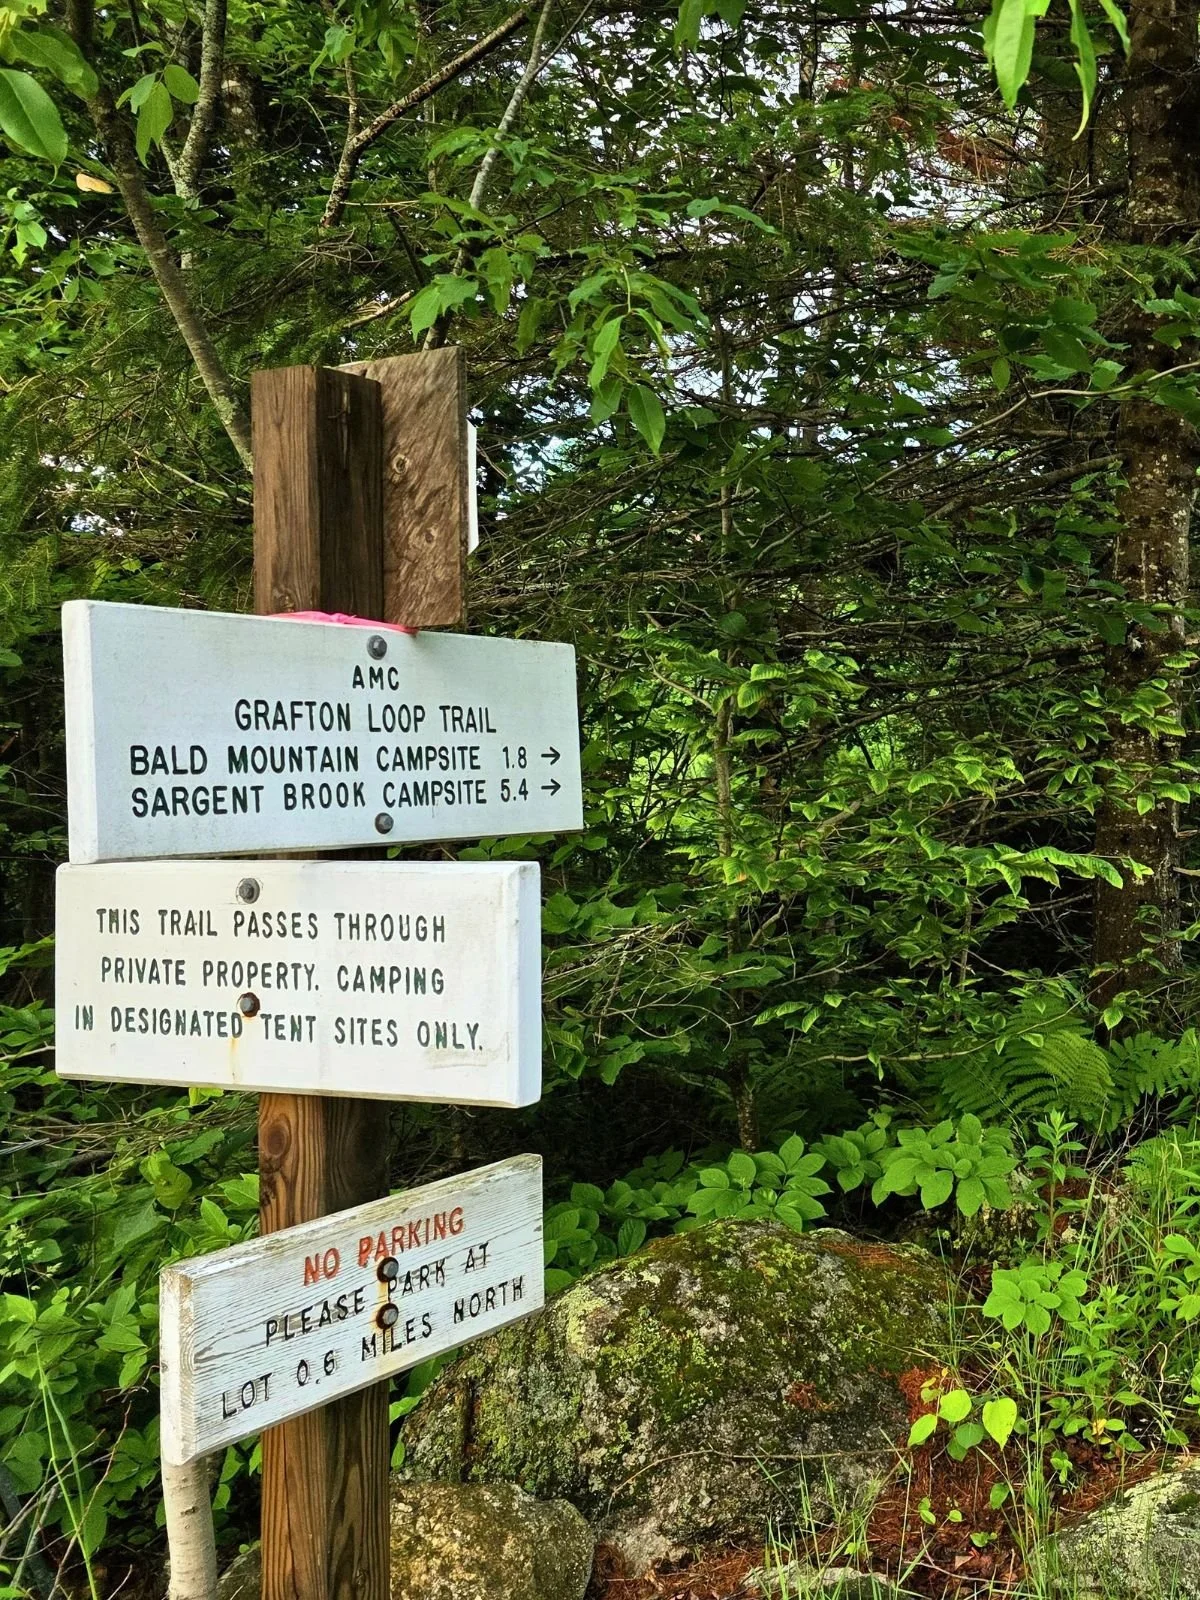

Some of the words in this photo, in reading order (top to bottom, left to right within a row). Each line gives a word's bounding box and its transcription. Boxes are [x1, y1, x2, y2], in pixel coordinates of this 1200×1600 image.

[352, 664, 400, 690] AMC
[234, 699, 352, 733] GRAFTON
[368, 704, 427, 733] LOOP
[439, 704, 497, 734] TRAIL
[129, 744, 208, 776] BALD
[227, 745, 359, 774] MOUNTAIN
[376, 745, 481, 772] CAMPSITE
[502, 747, 528, 769] 1.8
[131, 785, 265, 819] SARGENT
[284, 781, 365, 811] BROOK
[382, 779, 487, 808] CAMPSITE
[500, 778, 529, 801] 5.4
[96, 908, 140, 936] THIS
[157, 909, 218, 937] TRAIL
[233, 910, 319, 940] PASSES
[334, 912, 446, 943] THROUGH
[101, 957, 186, 986] PRIVATE
[202, 960, 320, 992] PROPERTY.
[337, 965, 445, 995] CAMPING
[74, 1004, 94, 1031] IN
[110, 1006, 243, 1039] DESIGNATED
[260, 1013, 316, 1044] TENT
[334, 1017, 398, 1047] SITES
[417, 1021, 484, 1052] ONLY.
[303, 1248, 340, 1286] NO
[357, 1206, 465, 1268] PARKING
[265, 1287, 366, 1347] PLEASE
[386, 1259, 447, 1306] PARK
[464, 1242, 489, 1274] AT
[221, 1372, 272, 1419] LOT
[296, 1350, 336, 1386] 0.6
[361, 1312, 432, 1363] MILES
[453, 1275, 524, 1324] NORTH
